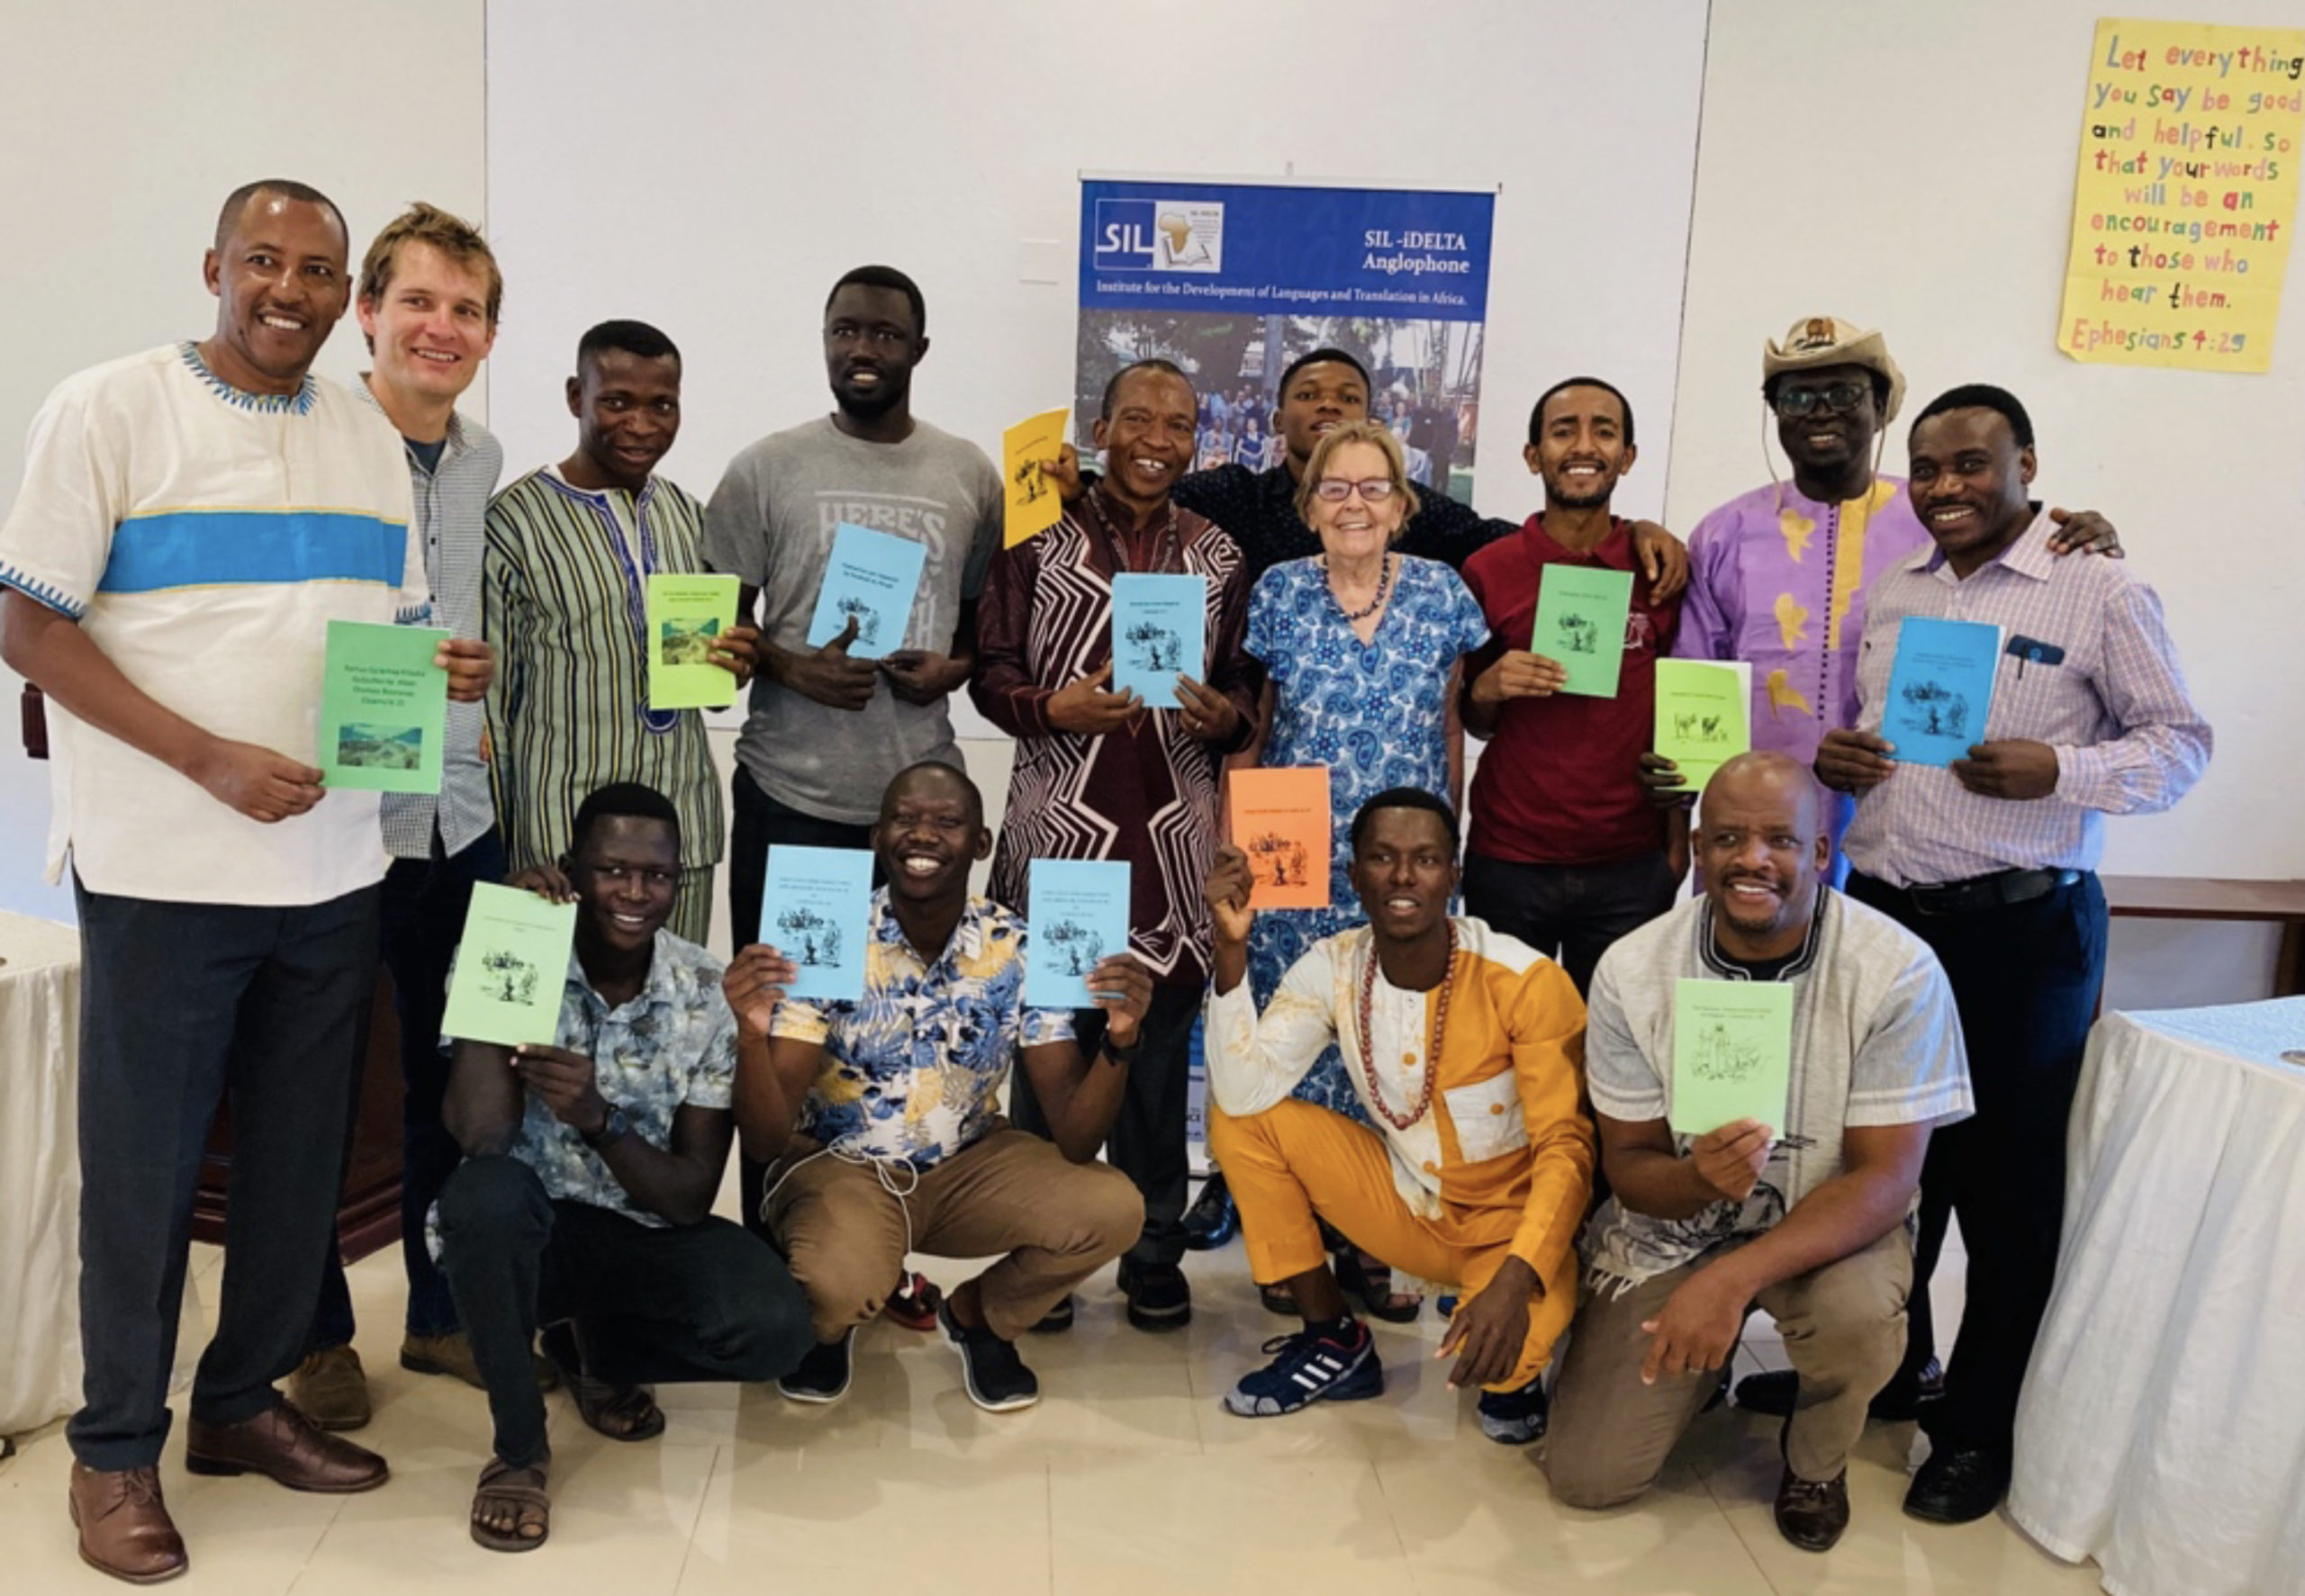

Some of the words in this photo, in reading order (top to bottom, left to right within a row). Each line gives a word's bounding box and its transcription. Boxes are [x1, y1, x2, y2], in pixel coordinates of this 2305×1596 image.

[2107, 34, 2147, 72] Let
[2165, 44, 2304, 80] everything
[2093, 82, 2138, 109] you
[2201, 87, 2230, 112] be
[2246, 89, 2302, 114] good
[2092, 117, 2136, 141] and
[2264, 131, 2291, 153] so
[2094, 149, 2148, 175] that
[2157, 156, 2210, 180] your
[2214, 158, 2279, 182] words
[2124, 182, 2166, 206] will
[2180, 185, 2208, 208] be
[2222, 191, 2254, 212] an
[1096, 223, 1153, 253] SIL
[1364, 230, 1393, 248] SIL
[2091, 213, 2280, 244] encouragement
[1362, 251, 1470, 275] Anglophone
[2094, 242, 2119, 266] to
[2128, 243, 2194, 269] those
[2204, 248, 2249, 274] who
[1097, 279, 1143, 293] Institute
[1144, 280, 1161, 294] for
[1162, 281, 1180, 295] the
[1182, 282, 1256, 300] Development
[1257, 285, 1270, 298] of
[1271, 285, 1329, 303] Languages
[1330, 289, 1351, 302] and
[1353, 287, 1416, 303] Translation
[1418, 293, 1430, 303] in
[1432, 290, 1468, 306] Africa.
[2101, 278, 2157, 304] hear
[2168, 281, 2232, 310] them.
[2071, 317, 2186, 352] Ephesians
[2192, 329, 2246, 354] 4:29
